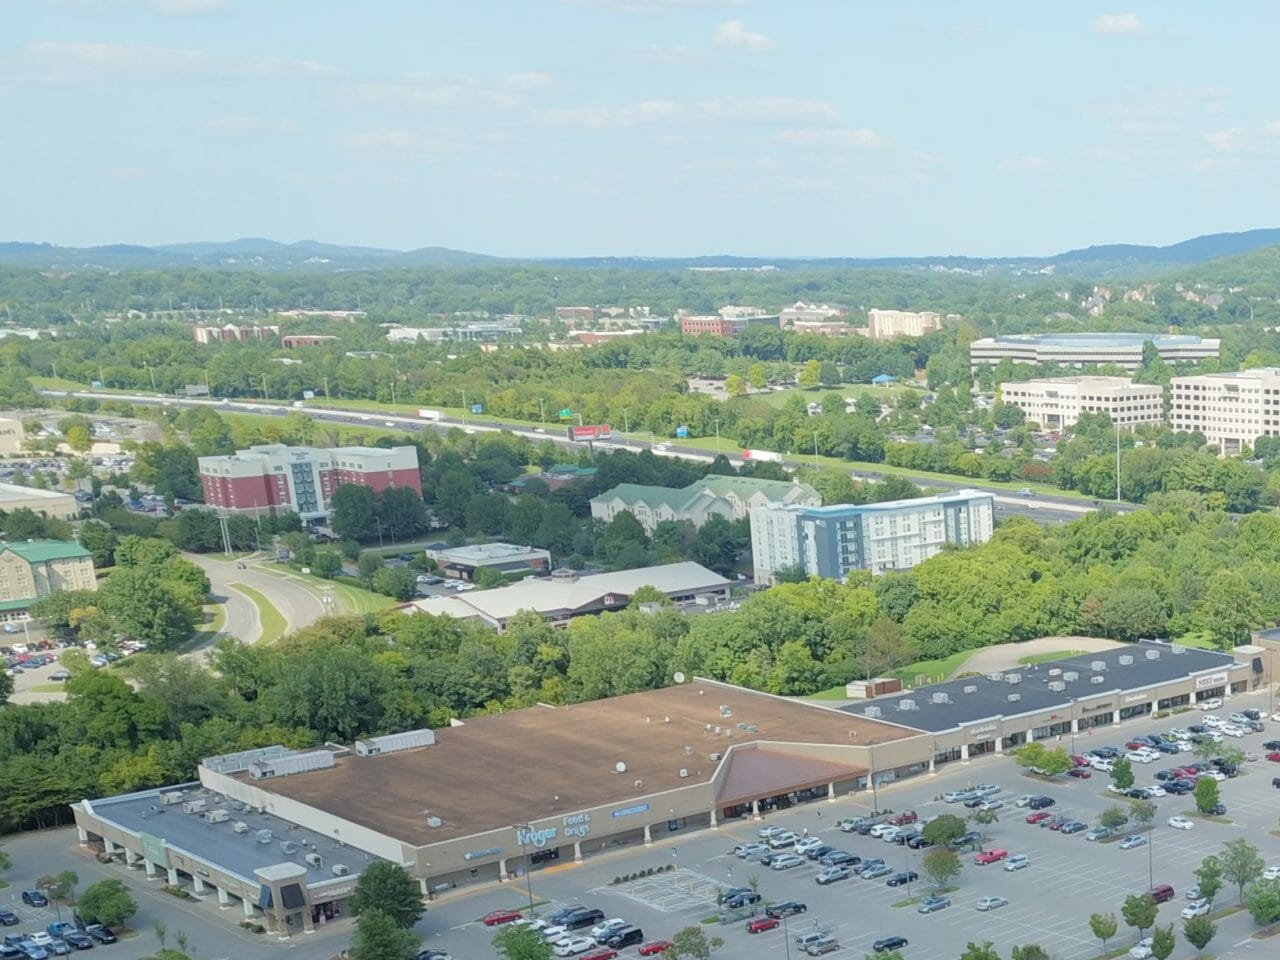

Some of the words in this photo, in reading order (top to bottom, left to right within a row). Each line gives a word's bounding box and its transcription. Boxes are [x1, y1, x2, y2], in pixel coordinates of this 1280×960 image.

[563, 814, 584, 826] Food
[516, 825, 557, 847] Kroger
[565, 825, 590, 837] Drugs
